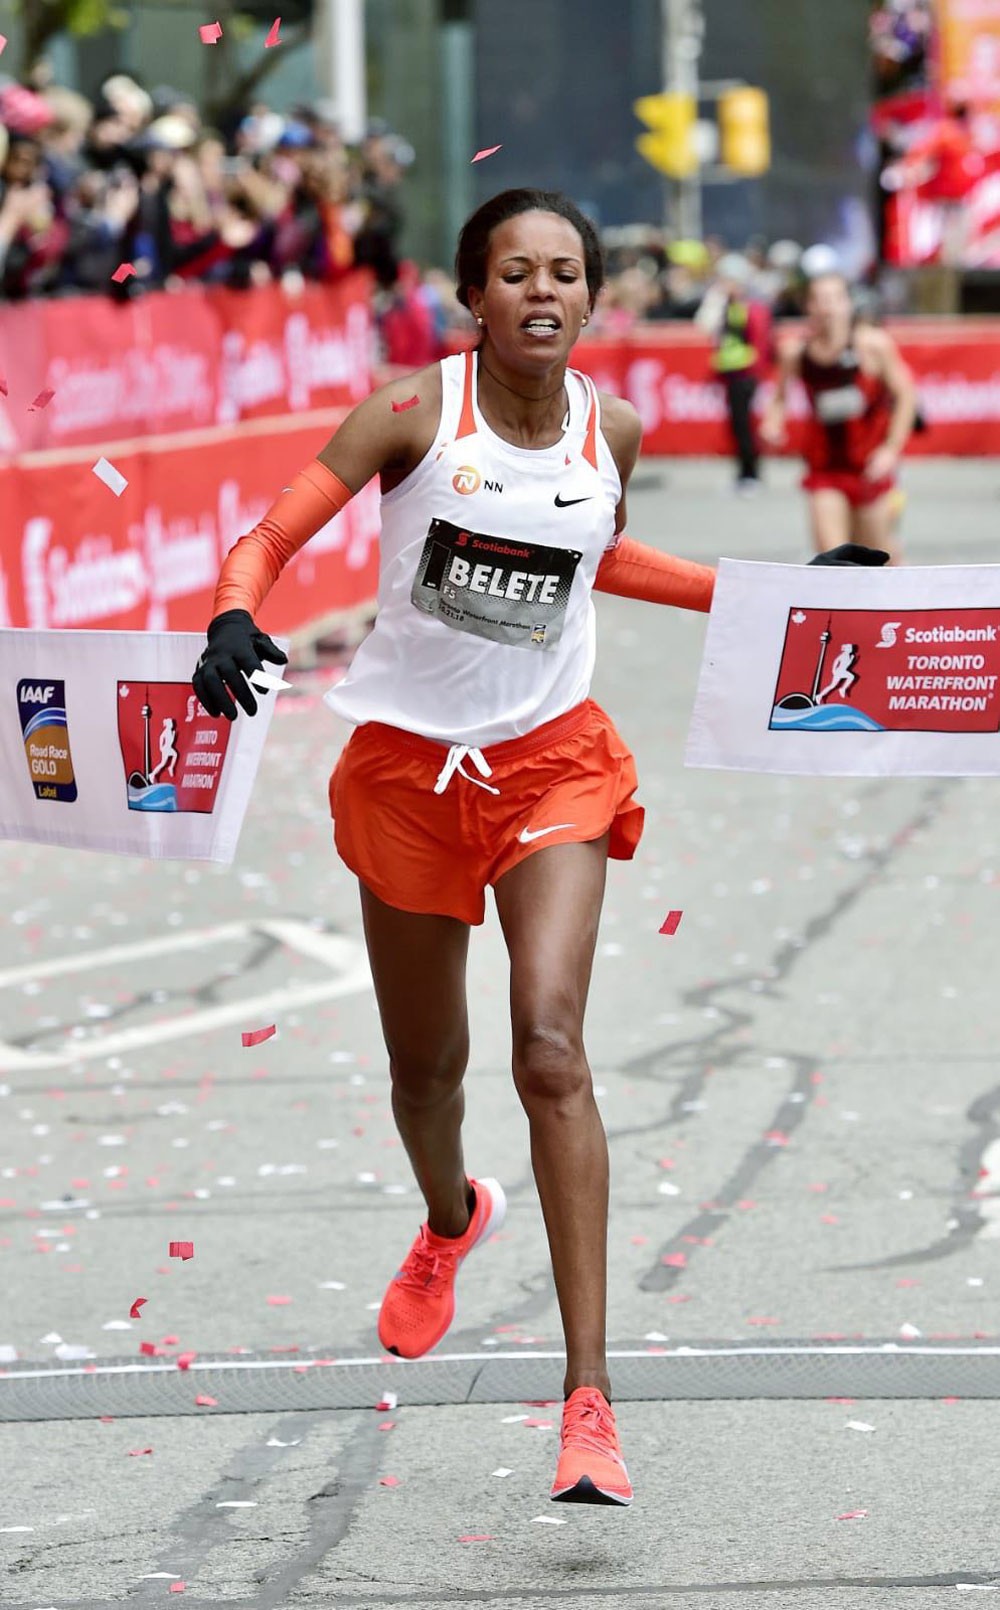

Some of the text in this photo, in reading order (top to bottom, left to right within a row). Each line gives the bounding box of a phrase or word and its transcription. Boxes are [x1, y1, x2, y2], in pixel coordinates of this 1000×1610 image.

[484, 480, 504, 494] NN
[472, 539, 530, 558] Scotiabank
[448, 555, 560, 604] BELETE
[462, 610, 498, 625] Waterfront
[499, 619, 531, 630] Marathon
[904, 625, 997, 643] Scotiabank
[907, 654, 985, 670] TORONTO
[886, 675, 998, 691] WATERFRONT
[20, 685, 55, 704] IAAF
[29, 743, 67, 759] Road Race
[31, 759, 57, 775] GOLD
[38, 785, 57, 798] Label
